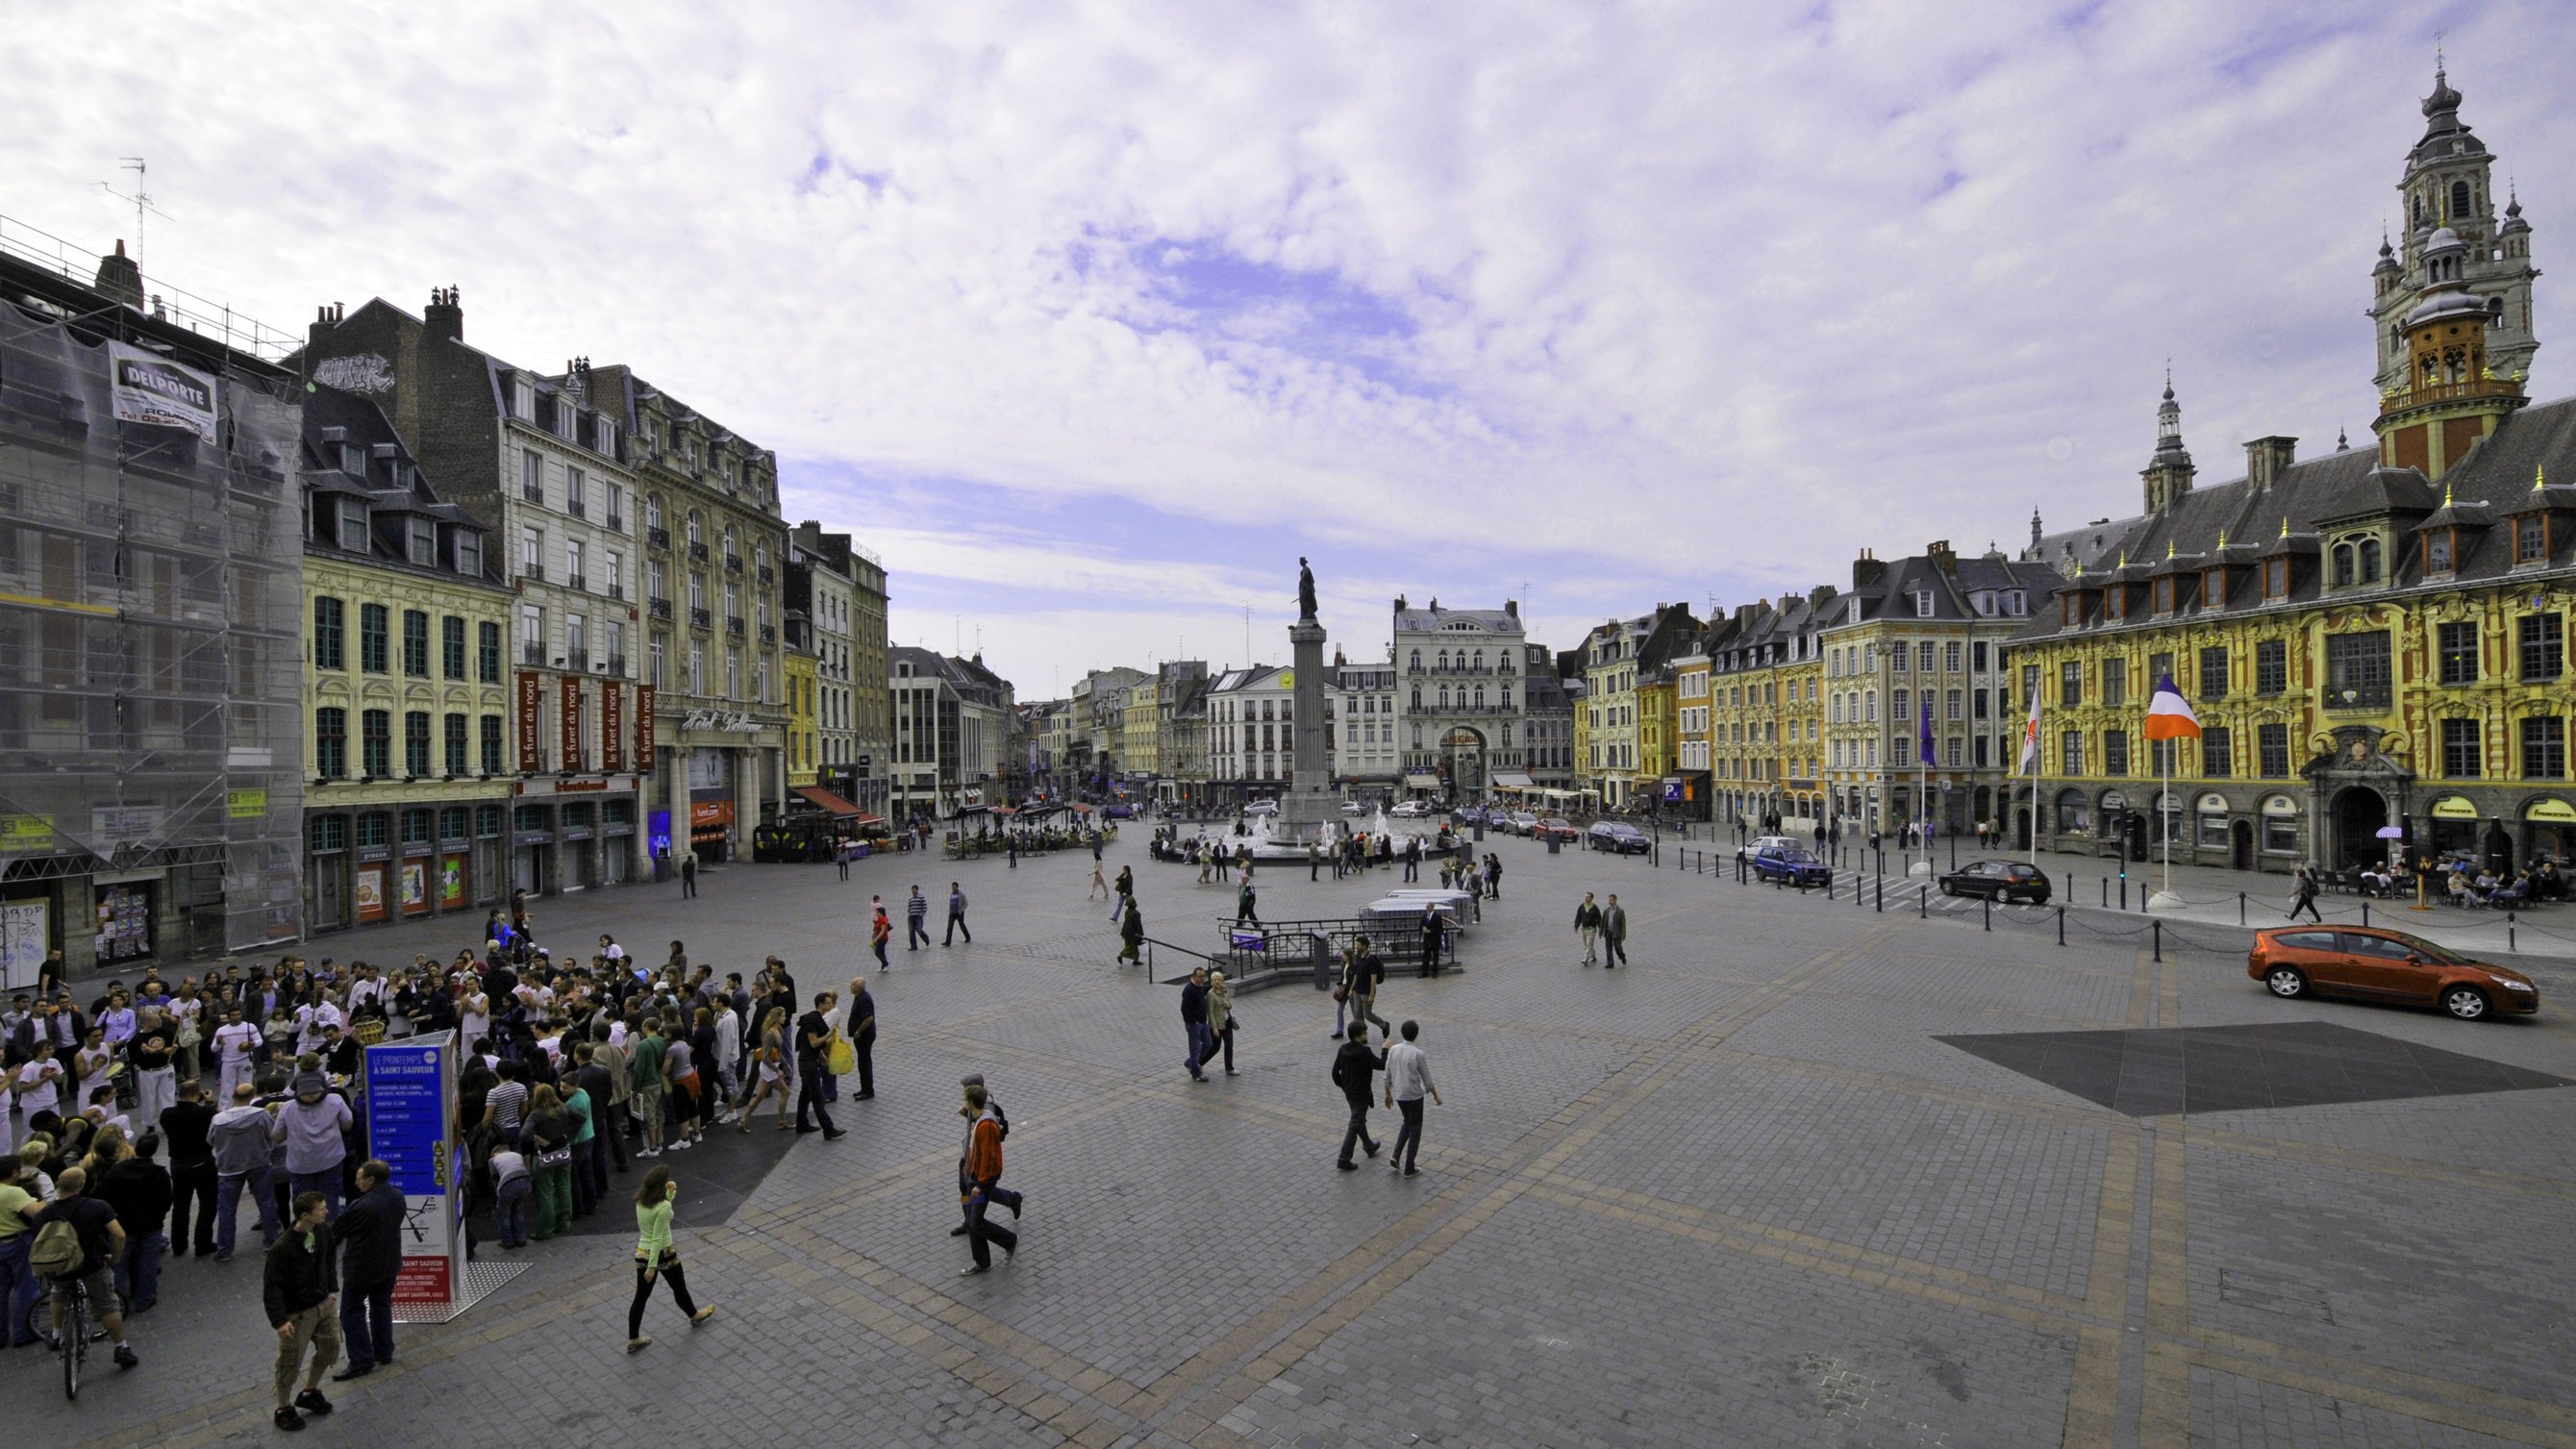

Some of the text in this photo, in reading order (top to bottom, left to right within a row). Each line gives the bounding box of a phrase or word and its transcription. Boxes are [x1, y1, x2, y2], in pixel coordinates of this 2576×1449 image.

[127, 366, 205, 406] DELPORTE
[523, 681, 536, 763] le furet du nord
[565, 685, 577, 763] le furet du nord
[606, 688, 617, 763] le furet du nord
[640, 691, 651, 762] le furet du nord
[1665, 785, 1674, 797] P
[363, 851, 388, 861] presse
[405, 846, 433, 856] activités
[372, 1055, 422, 1065] LE PRINTEMPS
[380, 1066, 401, 1075] SAINT
[402, 1065, 435, 1074] SAUVEUR
